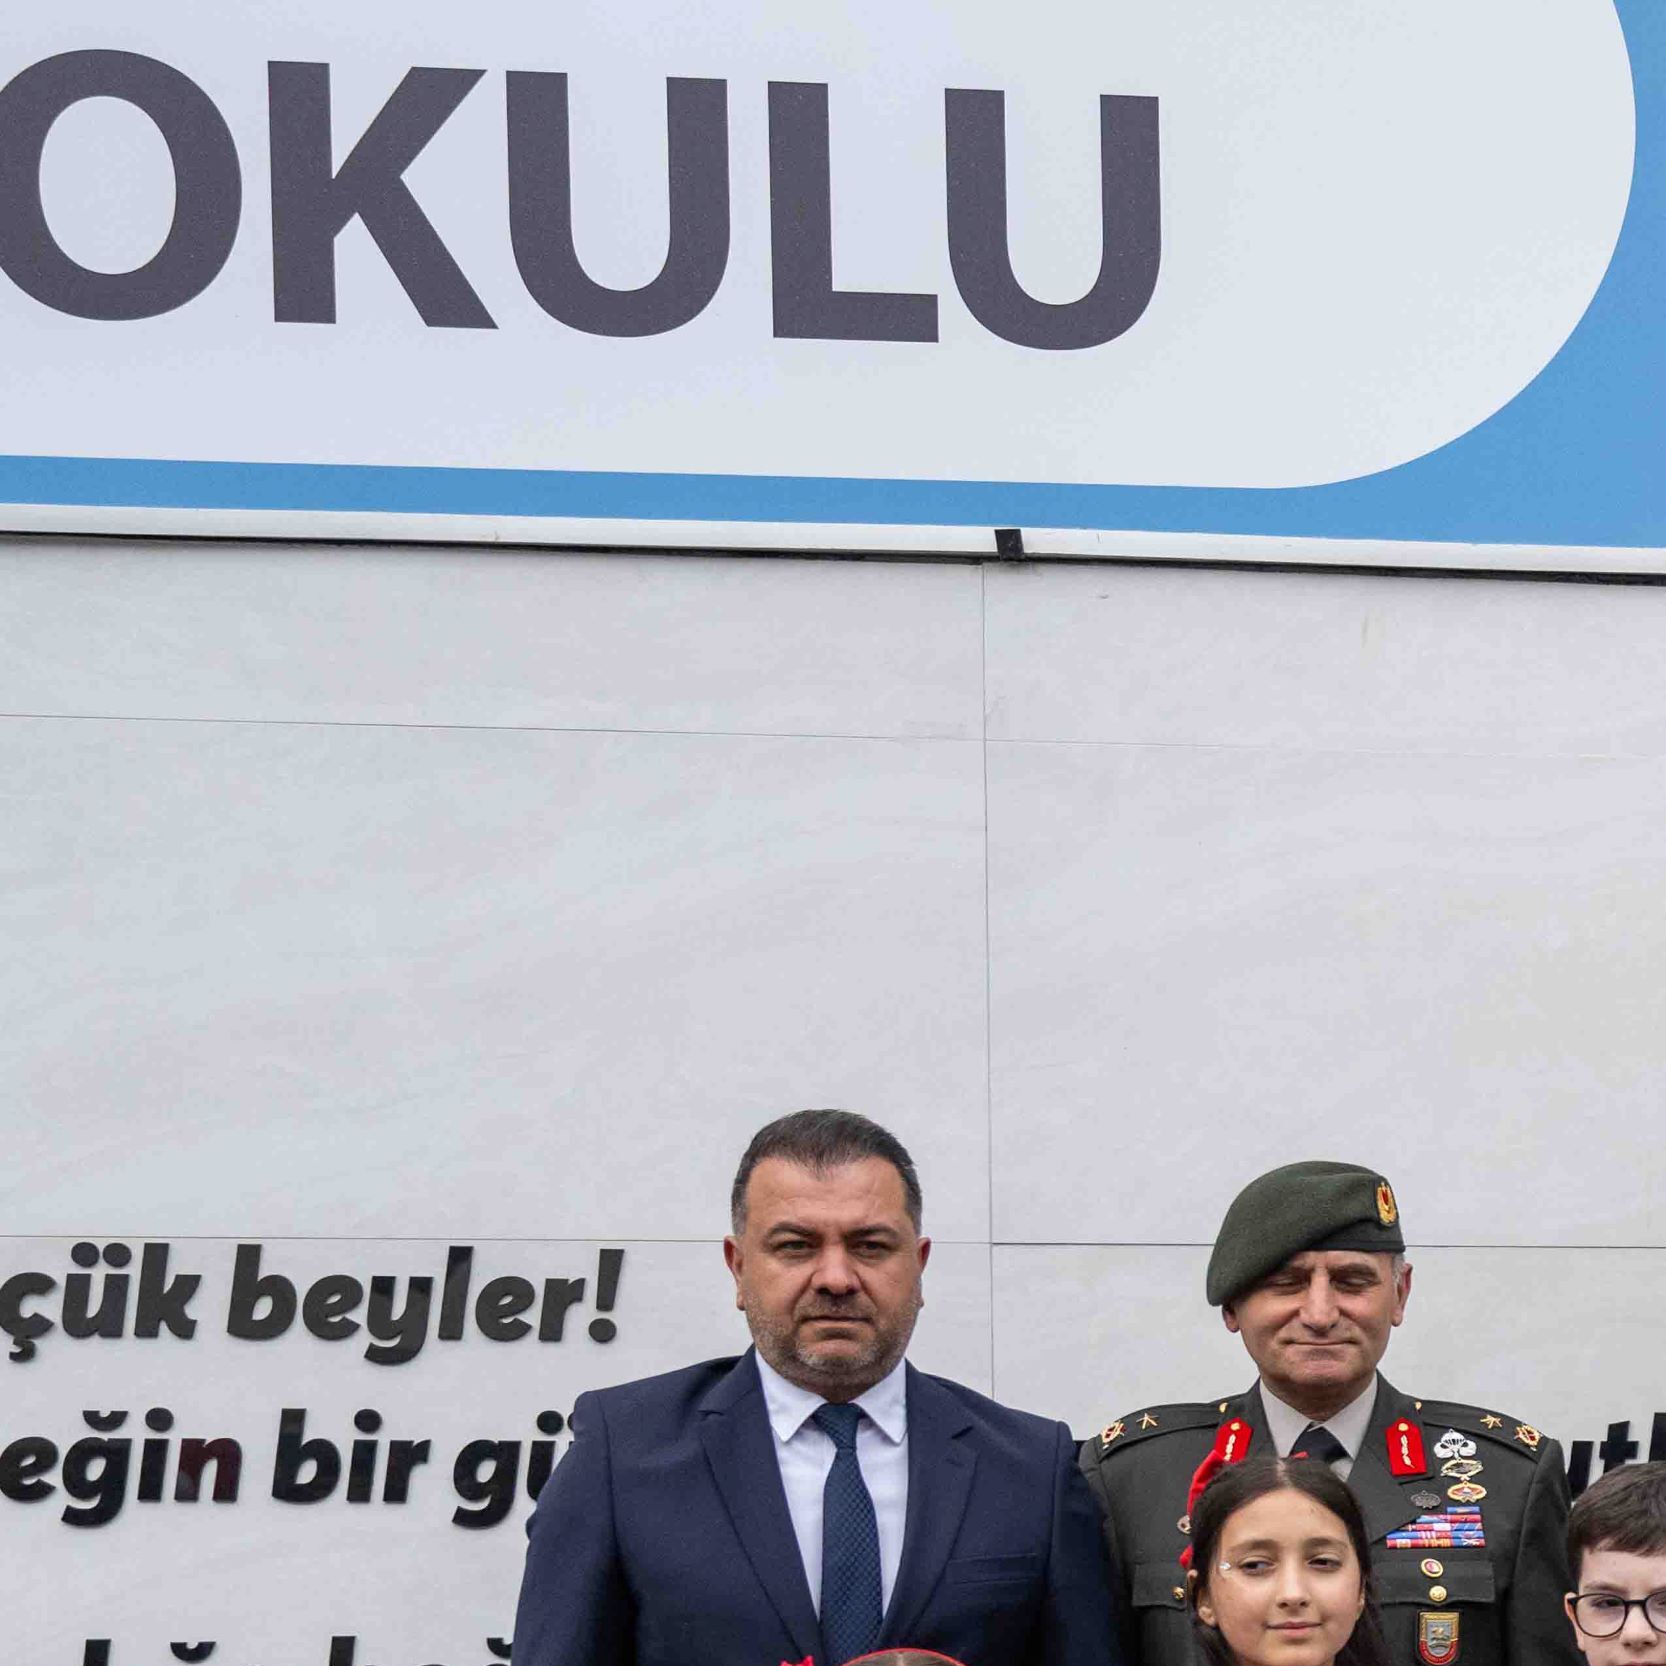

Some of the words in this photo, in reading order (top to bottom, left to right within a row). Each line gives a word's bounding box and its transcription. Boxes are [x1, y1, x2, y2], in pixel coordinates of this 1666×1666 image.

[0, 49, 1162, 351] OKULU
[0, 1242, 202, 1362] çük
[227, 1244, 625, 1366] beyler!
[0, 1410, 243, 1527] eğin
[271, 1408, 432, 1504] bir
